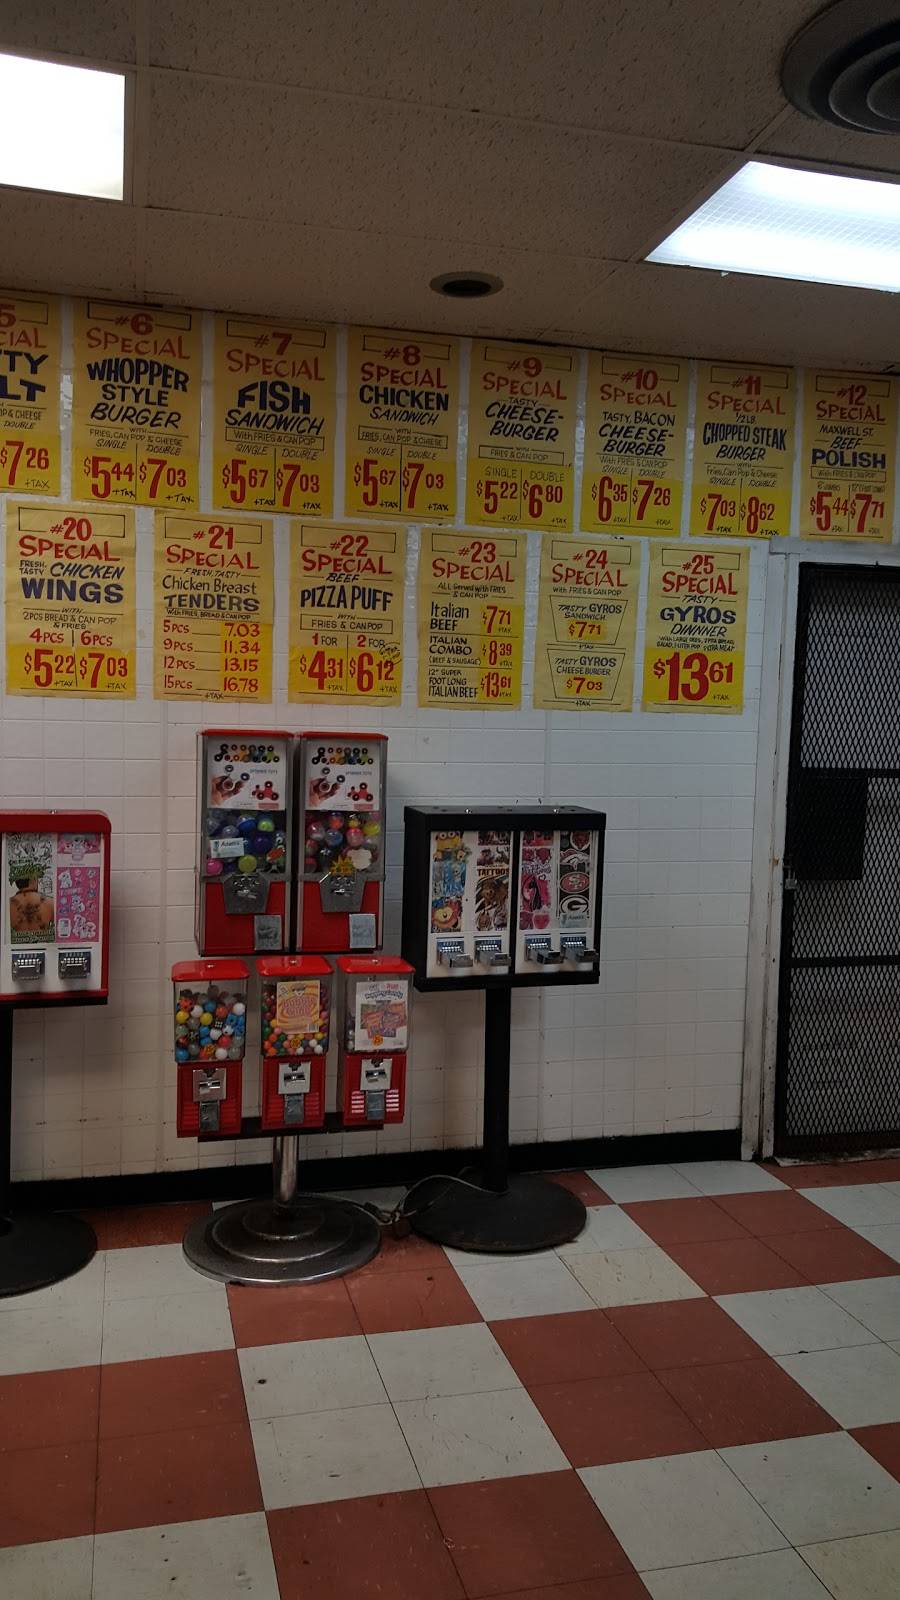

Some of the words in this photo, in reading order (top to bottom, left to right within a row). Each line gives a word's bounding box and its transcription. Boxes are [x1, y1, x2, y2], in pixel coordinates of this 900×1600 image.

[114, 313, 154, 335] #6
[86, 327, 190, 359] SPECIAL
[254, 331, 292, 355] #7
[226, 349, 325, 381] SPECIAL
[384, 345, 420, 365] #8
[86, 358, 189, 392] WHOPPER
[360, 362, 447, 389] SPECIAL
[507, 357, 542, 377] #9
[483, 372, 567, 400] SPECIAL
[621, 368, 658, 390] #10
[731, 375, 761, 395] #11
[102, 384, 168, 407] STYLE
[238, 380, 310, 414] FISH
[359, 384, 448, 411] CHICKEN
[509, 397, 537, 407] TASTY
[600, 384, 677, 407] SPECIAL
[708, 391, 785, 415] SPECIAL
[837, 384, 867, 406] #12
[91, 403, 181, 429] BURGER
[370, 407, 439, 425] SANDWICH
[485, 402, 564, 424] CHEESE-
[634, 411, 676, 426] BACON
[815, 400, 885, 422] SPECIAL
[225, 409, 324, 435] SANDWICH
[490, 421, 559, 442] BURGER
[820, 424, 861, 436] MAXWELL
[113, 432, 129, 440] CAN
[254, 432, 275, 442] FRIES
[299, 437, 315, 445] POP
[599, 423, 674, 442] CHEESE-
[703, 423, 750, 445] CHOPPED
[753, 427, 786, 450] STEAK
[830, 436, 862, 449] BEEF
[96, 439, 126, 449] SINGLE
[235, 444, 268, 455] SINGLE
[603, 439, 665, 456] BURGER
[716, 445, 766, 461] BURGER
[812, 448, 886, 469] POLISH
[485, 466, 517, 478] SINGLE
[530, 471, 564, 482] DOUBLE
[50, 517, 92, 541] #20
[193, 525, 234, 550] #21
[19, 535, 120, 562] SPECIAL
[330, 535, 369, 557] #22
[458, 541, 496, 563] #23
[167, 545, 260, 570] SPECIAL
[301, 549, 392, 574] SPECIAL
[573, 549, 608, 569] #24
[682, 555, 714, 575] #25
[50, 562, 125, 580] CHICKEN
[326, 573, 360, 583] BEEF
[432, 558, 514, 583] SPECIAL
[552, 564, 627, 587] SPECIAL
[21, 577, 123, 604] WINGS
[163, 575, 210, 591] Chicken
[214, 578, 256, 594] Breast
[662, 572, 738, 595] SPECIAL
[164, 593, 260, 611] TENDERS
[300, 585, 347, 609] PIZZA
[351, 587, 393, 611] PUFF
[682, 595, 717, 604] TASTY
[45, 613, 68, 622] BREAD
[431, 602, 469, 618] Italian
[558, 604, 587, 612] TASTY
[589, 603, 622, 614] GYROS
[565, 612, 605, 620] SANDWICH
[661, 606, 736, 624] GYROS
[224, 624, 260, 637] 7.03
[311, 619, 337, 629] FRIES
[350, 621, 366, 630] CAN
[367, 622, 383, 631] POP
[430, 619, 458, 631] BEEF
[224, 640, 260, 654] 11.34
[312, 633, 319, 646] 1
[321, 636, 337, 646] FOR
[358, 635, 366, 647] 2
[368, 638, 385, 648] FOR
[429, 636, 467, 644] ITALIAN
[429, 645, 472, 655] COMBO
[224, 659, 258, 672] 13.15
[580, 656, 616, 667] GYROS
[223, 677, 258, 693] 16.78
[428, 686, 459, 697] ITALIAN
[460, 687, 478, 698] BEEF
